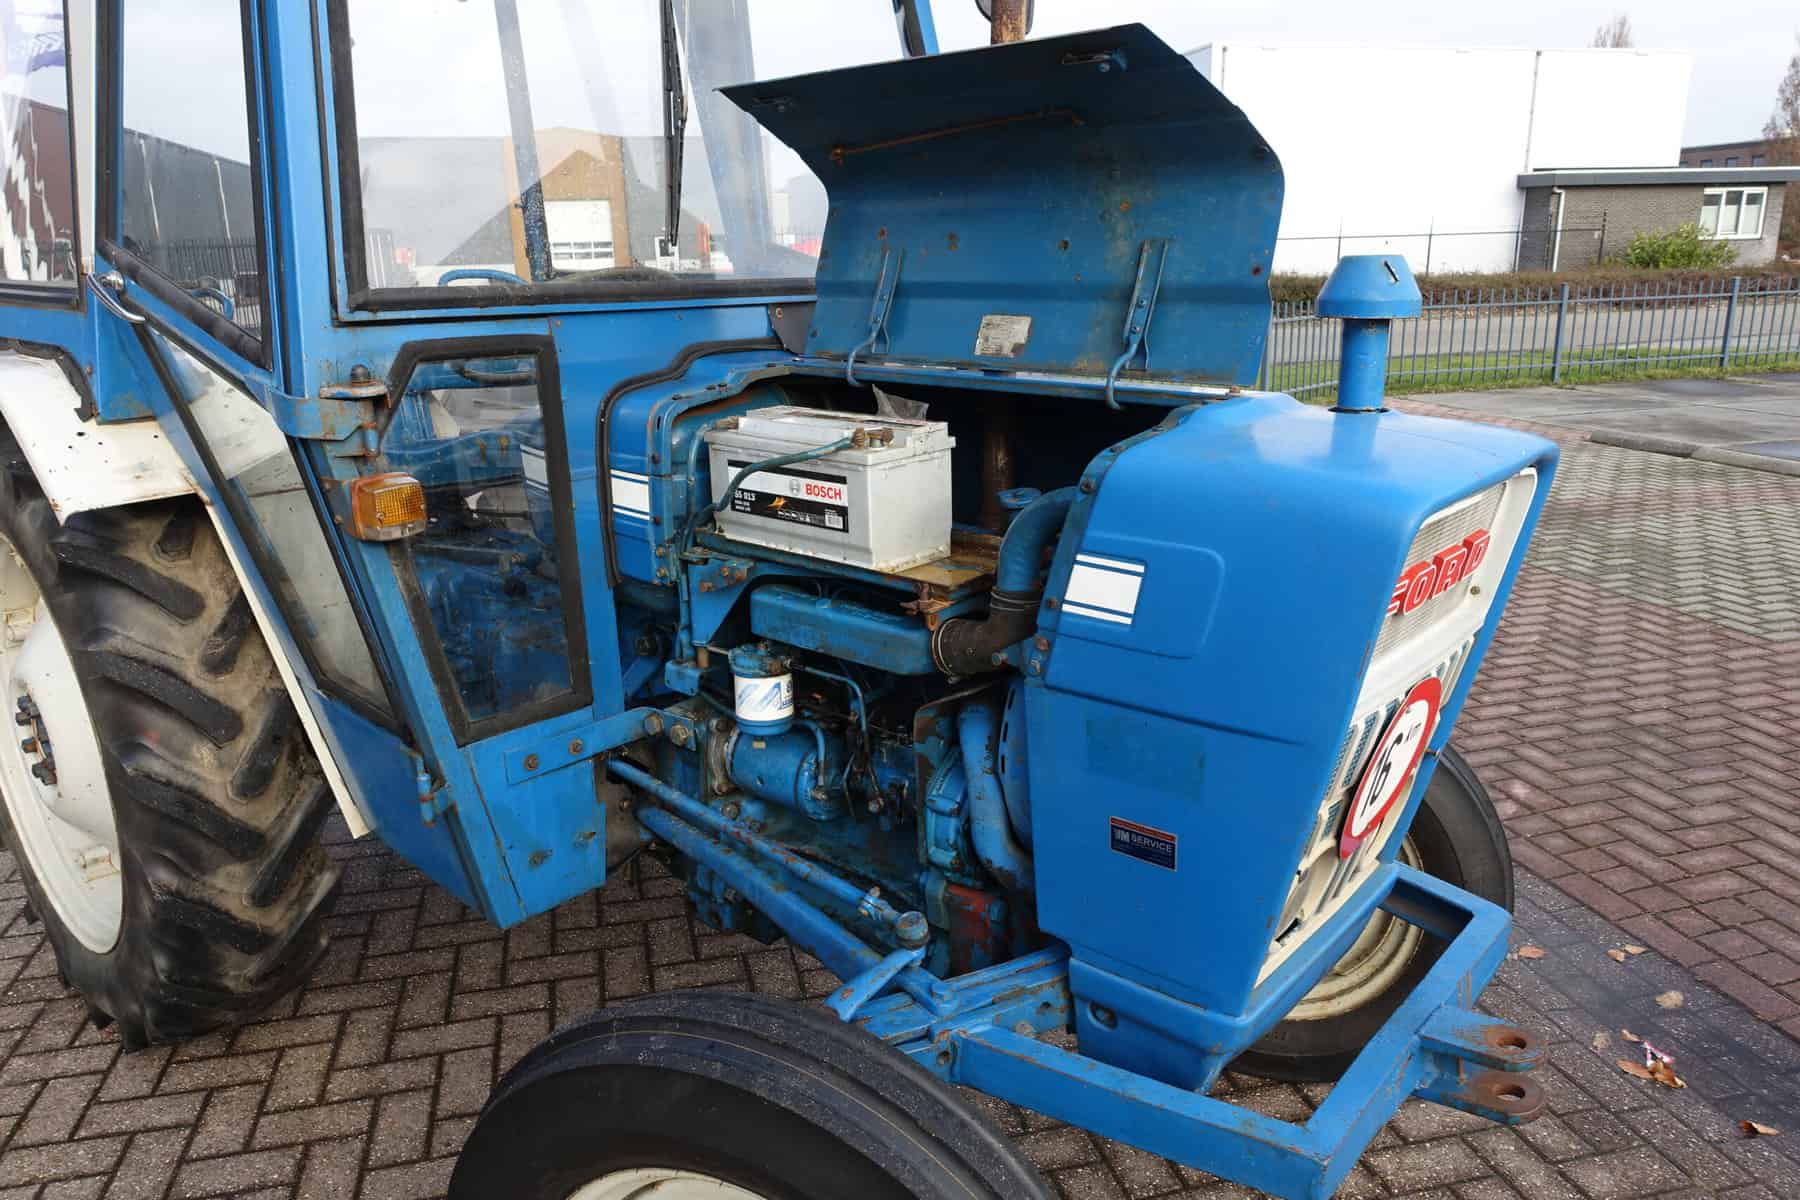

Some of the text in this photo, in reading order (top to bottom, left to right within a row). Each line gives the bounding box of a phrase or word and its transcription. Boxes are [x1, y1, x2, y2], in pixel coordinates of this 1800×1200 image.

[805, 482, 842, 500] BOSCH
[1360, 732, 1404, 818] 16
[1130, 832, 1173, 853] SERVICE
